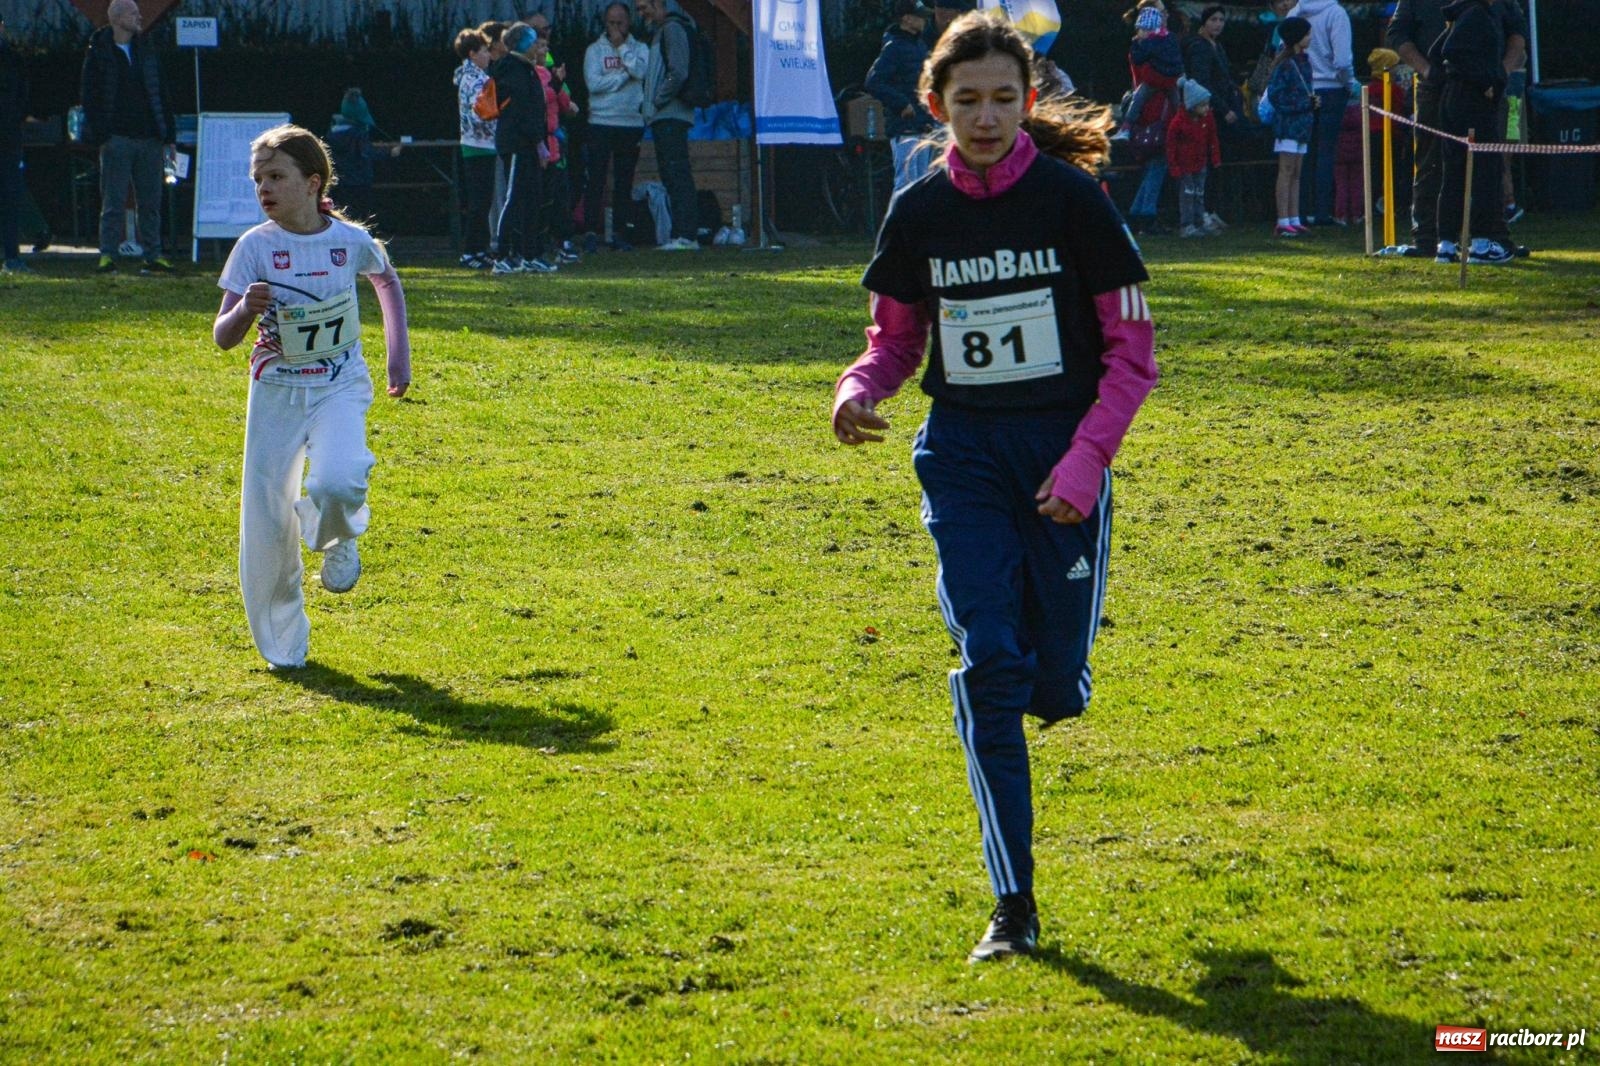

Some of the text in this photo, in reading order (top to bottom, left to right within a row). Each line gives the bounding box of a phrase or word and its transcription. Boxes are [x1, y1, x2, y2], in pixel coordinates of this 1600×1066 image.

[182, 20, 212, 29] ZAPISY
[779, 57, 817, 70] WIELKIE
[929, 248, 1062, 288] HANDBALL
[297, 316, 344, 351] 77
[962, 325, 1026, 368] 81
